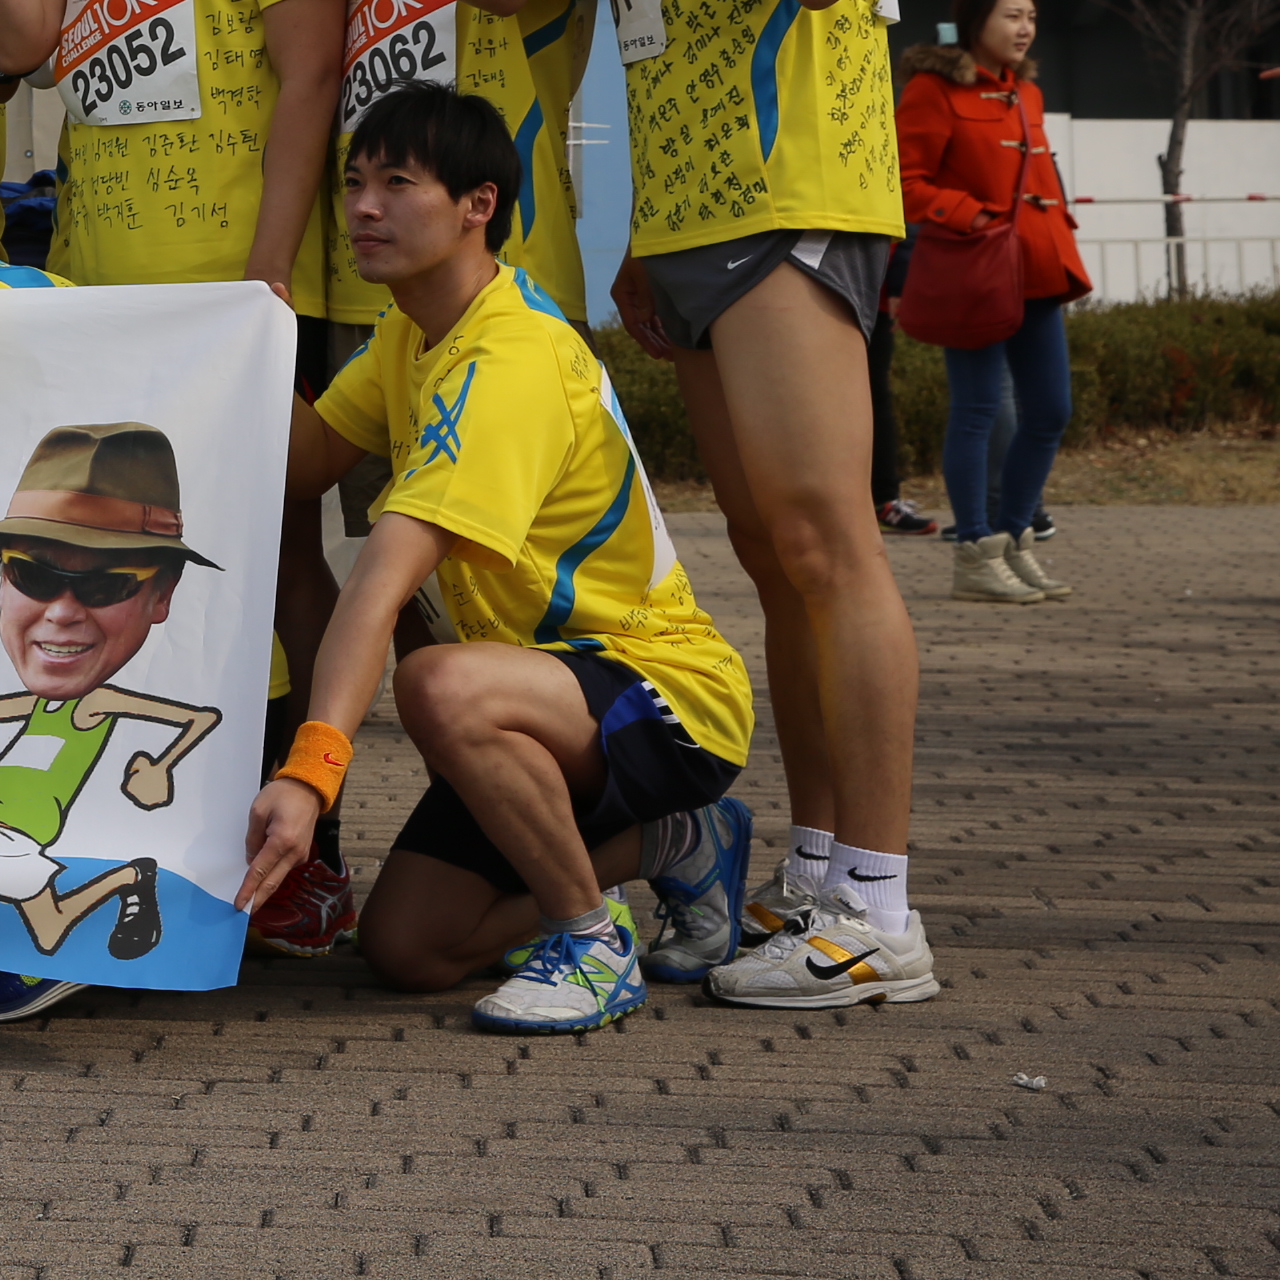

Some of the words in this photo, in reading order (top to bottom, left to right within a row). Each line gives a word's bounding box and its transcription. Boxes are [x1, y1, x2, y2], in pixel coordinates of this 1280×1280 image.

[61, 10, 99, 57] SEOUL
[61, 32, 103, 68] CHALLENGE
[71, 16, 187, 118] 23052
[342, 20, 447, 123] 23062
[135, 99, 185, 112] 동아일보
